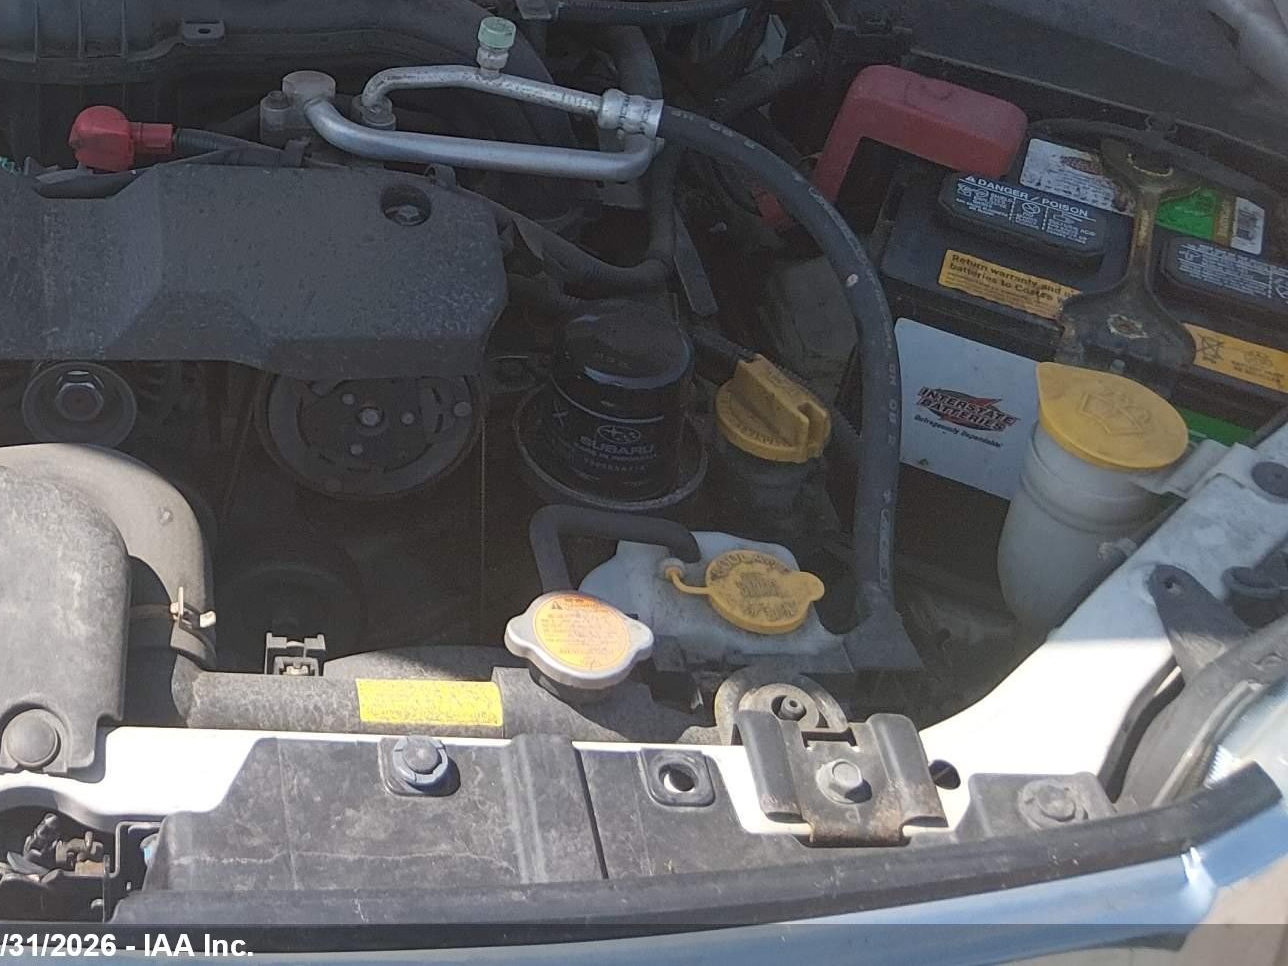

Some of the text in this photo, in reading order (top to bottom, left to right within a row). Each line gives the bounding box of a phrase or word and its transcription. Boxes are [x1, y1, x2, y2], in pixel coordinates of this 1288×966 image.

[977, 179, 1029, 200] DANGER
[1041, 198, 1089, 217] POISON
[950, 263, 998, 284] batteries
[951, 254, 988, 272] Return
[990, 268, 1038, 288] warranty
[916, 397, 1006, 433] BATTERIES
[917, 386, 1017, 427] INTERSTATE
[579, 435, 655, 454] SUBARU
